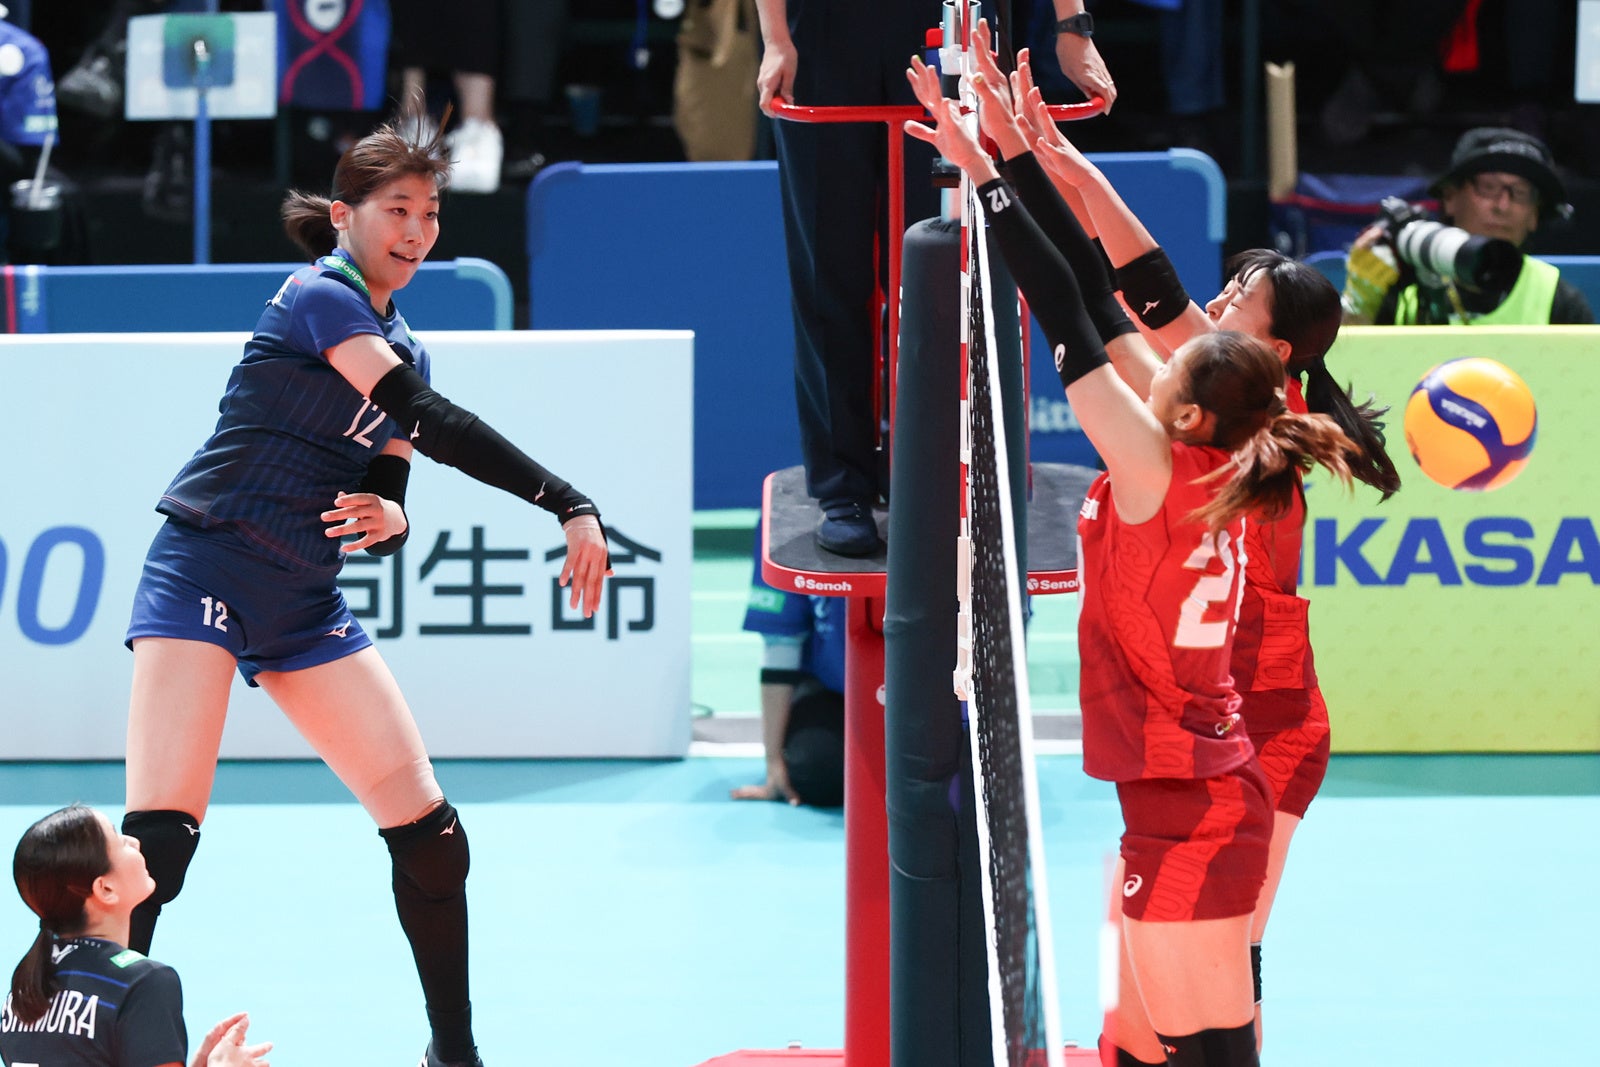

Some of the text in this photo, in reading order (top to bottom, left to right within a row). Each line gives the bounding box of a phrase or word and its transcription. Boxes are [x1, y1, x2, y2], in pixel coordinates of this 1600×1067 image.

[986, 186, 1011, 213] 12
[343, 396, 387, 449] 12
[1297, 516, 1600, 587] KASA
[806, 579, 852, 591] Senoh
[201, 596, 229, 633] 12
